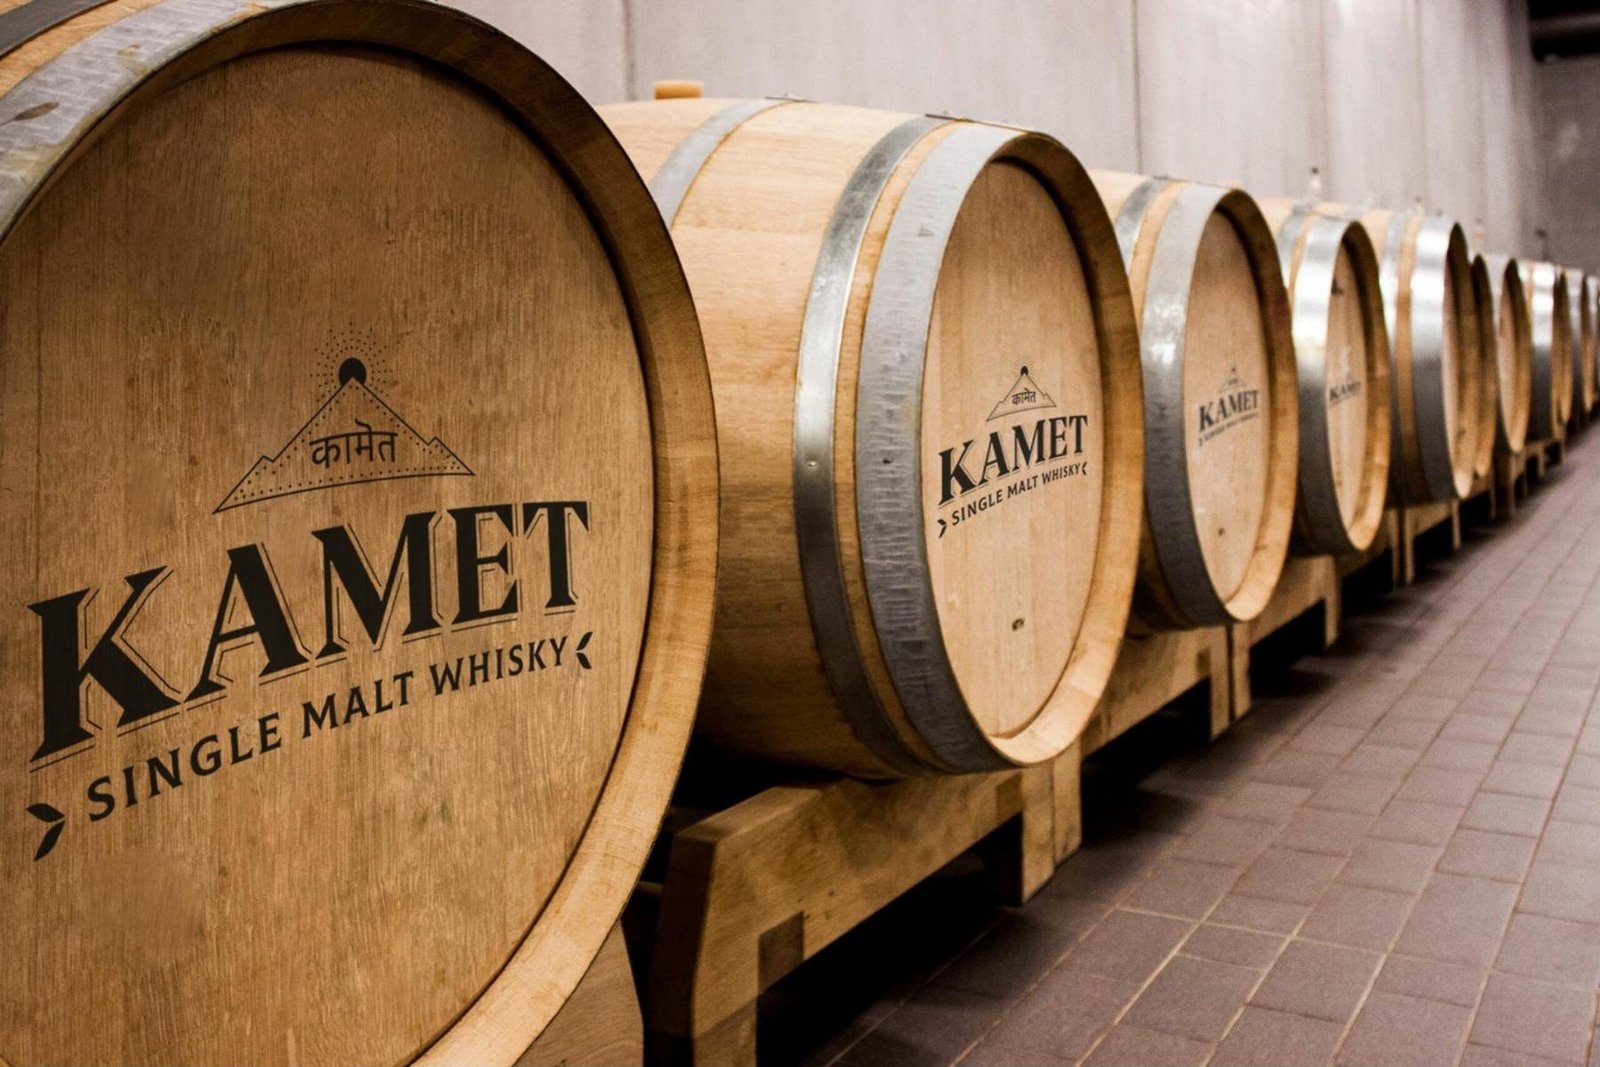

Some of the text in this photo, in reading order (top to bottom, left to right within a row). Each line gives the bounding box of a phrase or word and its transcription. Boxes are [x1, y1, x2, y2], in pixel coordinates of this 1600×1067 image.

[1012, 387, 1036, 405] कामेत
[1199, 390, 1259, 432] KAMET
[310, 418, 398, 469] कामेत
[938, 415, 1088, 508] KAMET
[952, 463, 1081, 526] SINGLE MALT WHISKY
[27, 501, 590, 772] KAMET
[86, 635, 568, 822] SINGLE MALT WHISKY
